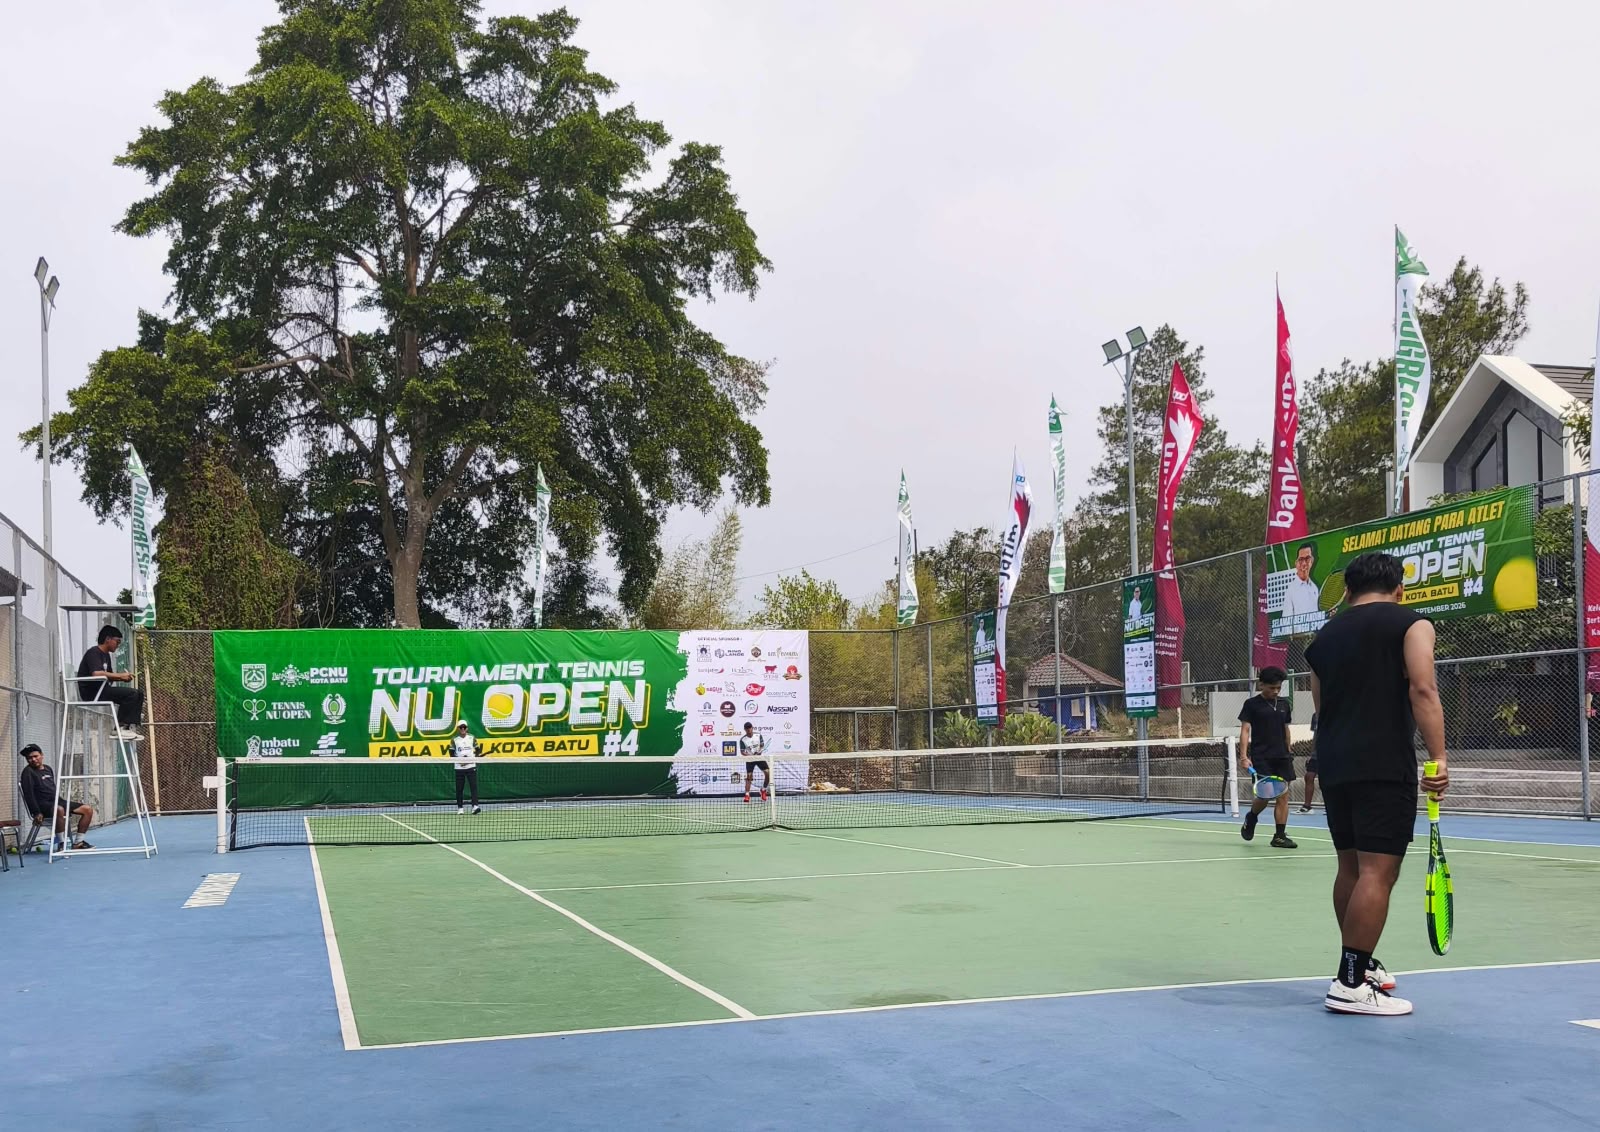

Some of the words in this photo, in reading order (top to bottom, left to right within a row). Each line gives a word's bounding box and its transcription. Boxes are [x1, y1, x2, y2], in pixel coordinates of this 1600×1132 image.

[1342, 528, 1388, 552] SELAMAT
[1389, 518, 1432, 541] DATANG
[1433, 510, 1465, 532] PARA
[1467, 500, 1506, 525] ATLET
[1437, 528, 1485, 548] TENNIS
[1402, 542, 1486, 586] OPEN
[1405, 591, 1427, 601] KOTA
[1430, 586, 1455, 597] BATU
[1463, 576, 1483, 597] #4
[1414, 604, 1449, 614] EPTEMBER
[310, 667, 348, 678] PCNU
[372, 663, 550, 685] TOURNAMENT
[558, 660, 645, 679] TENNIS
[271, 701, 306, 710] TENNIS
[368, 686, 460, 737] NU
[481, 680, 649, 732] OPEN
[766, 705, 794, 713] Nassau
[265, 710, 281, 720] NU
[281, 709, 312, 719] OPEN
[261, 737, 300, 748] mbatu
[379, 745, 432, 757] PIALA
[490, 742, 536, 754] KOTA
[543, 737, 590, 752] BATU
[603, 729, 639, 757] #4
[261, 748, 283, 756] sae
